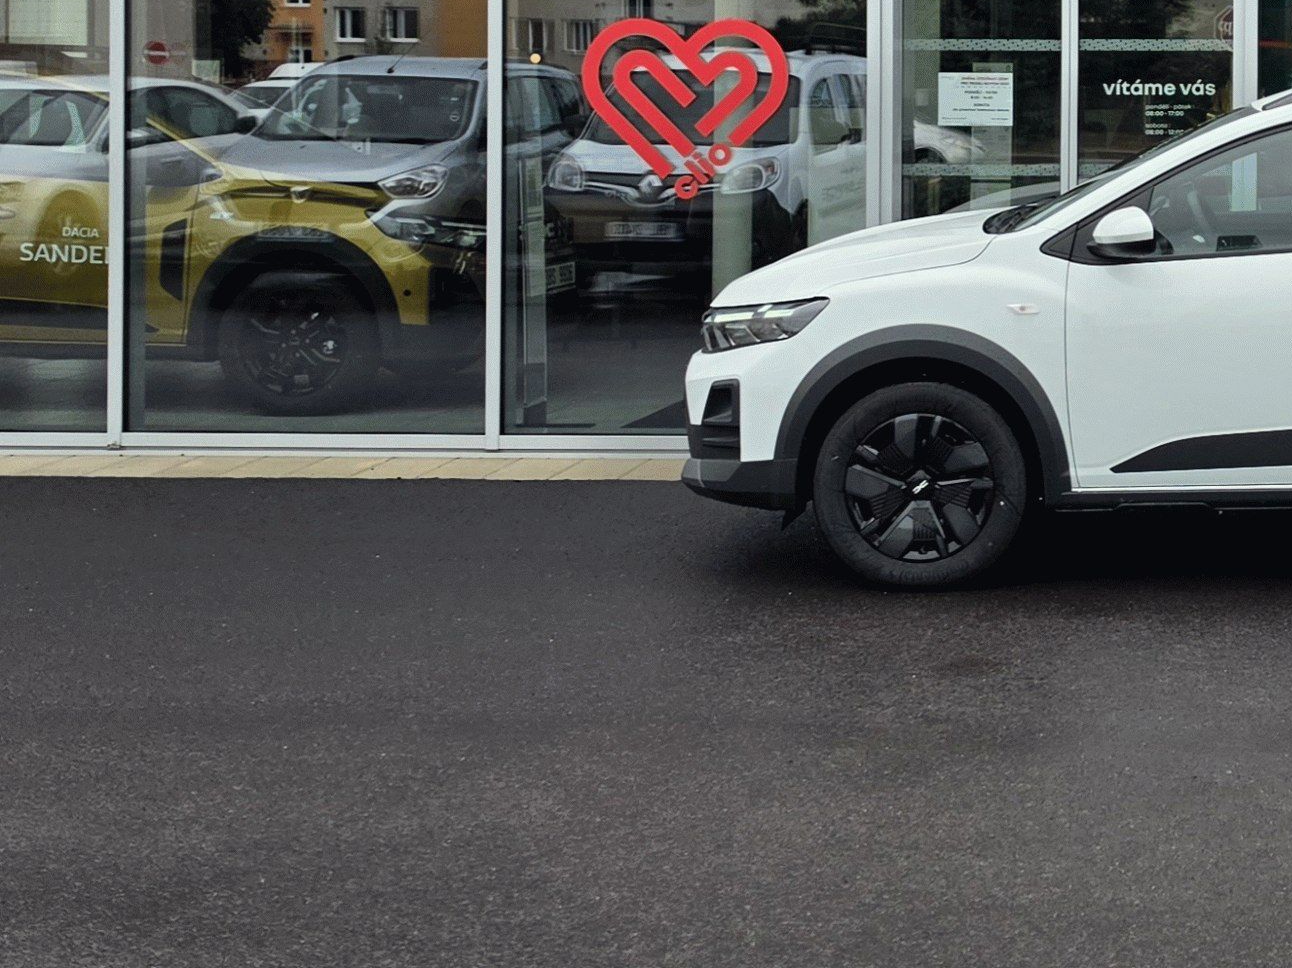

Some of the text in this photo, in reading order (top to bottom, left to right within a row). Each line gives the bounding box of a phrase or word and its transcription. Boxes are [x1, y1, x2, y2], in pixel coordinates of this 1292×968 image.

[1102, 79, 1217, 96] vítáme vás
[674, 143, 733, 200] clio
[62, 227, 99, 238] DACIA
[20, 242, 108, 264] SANDE
